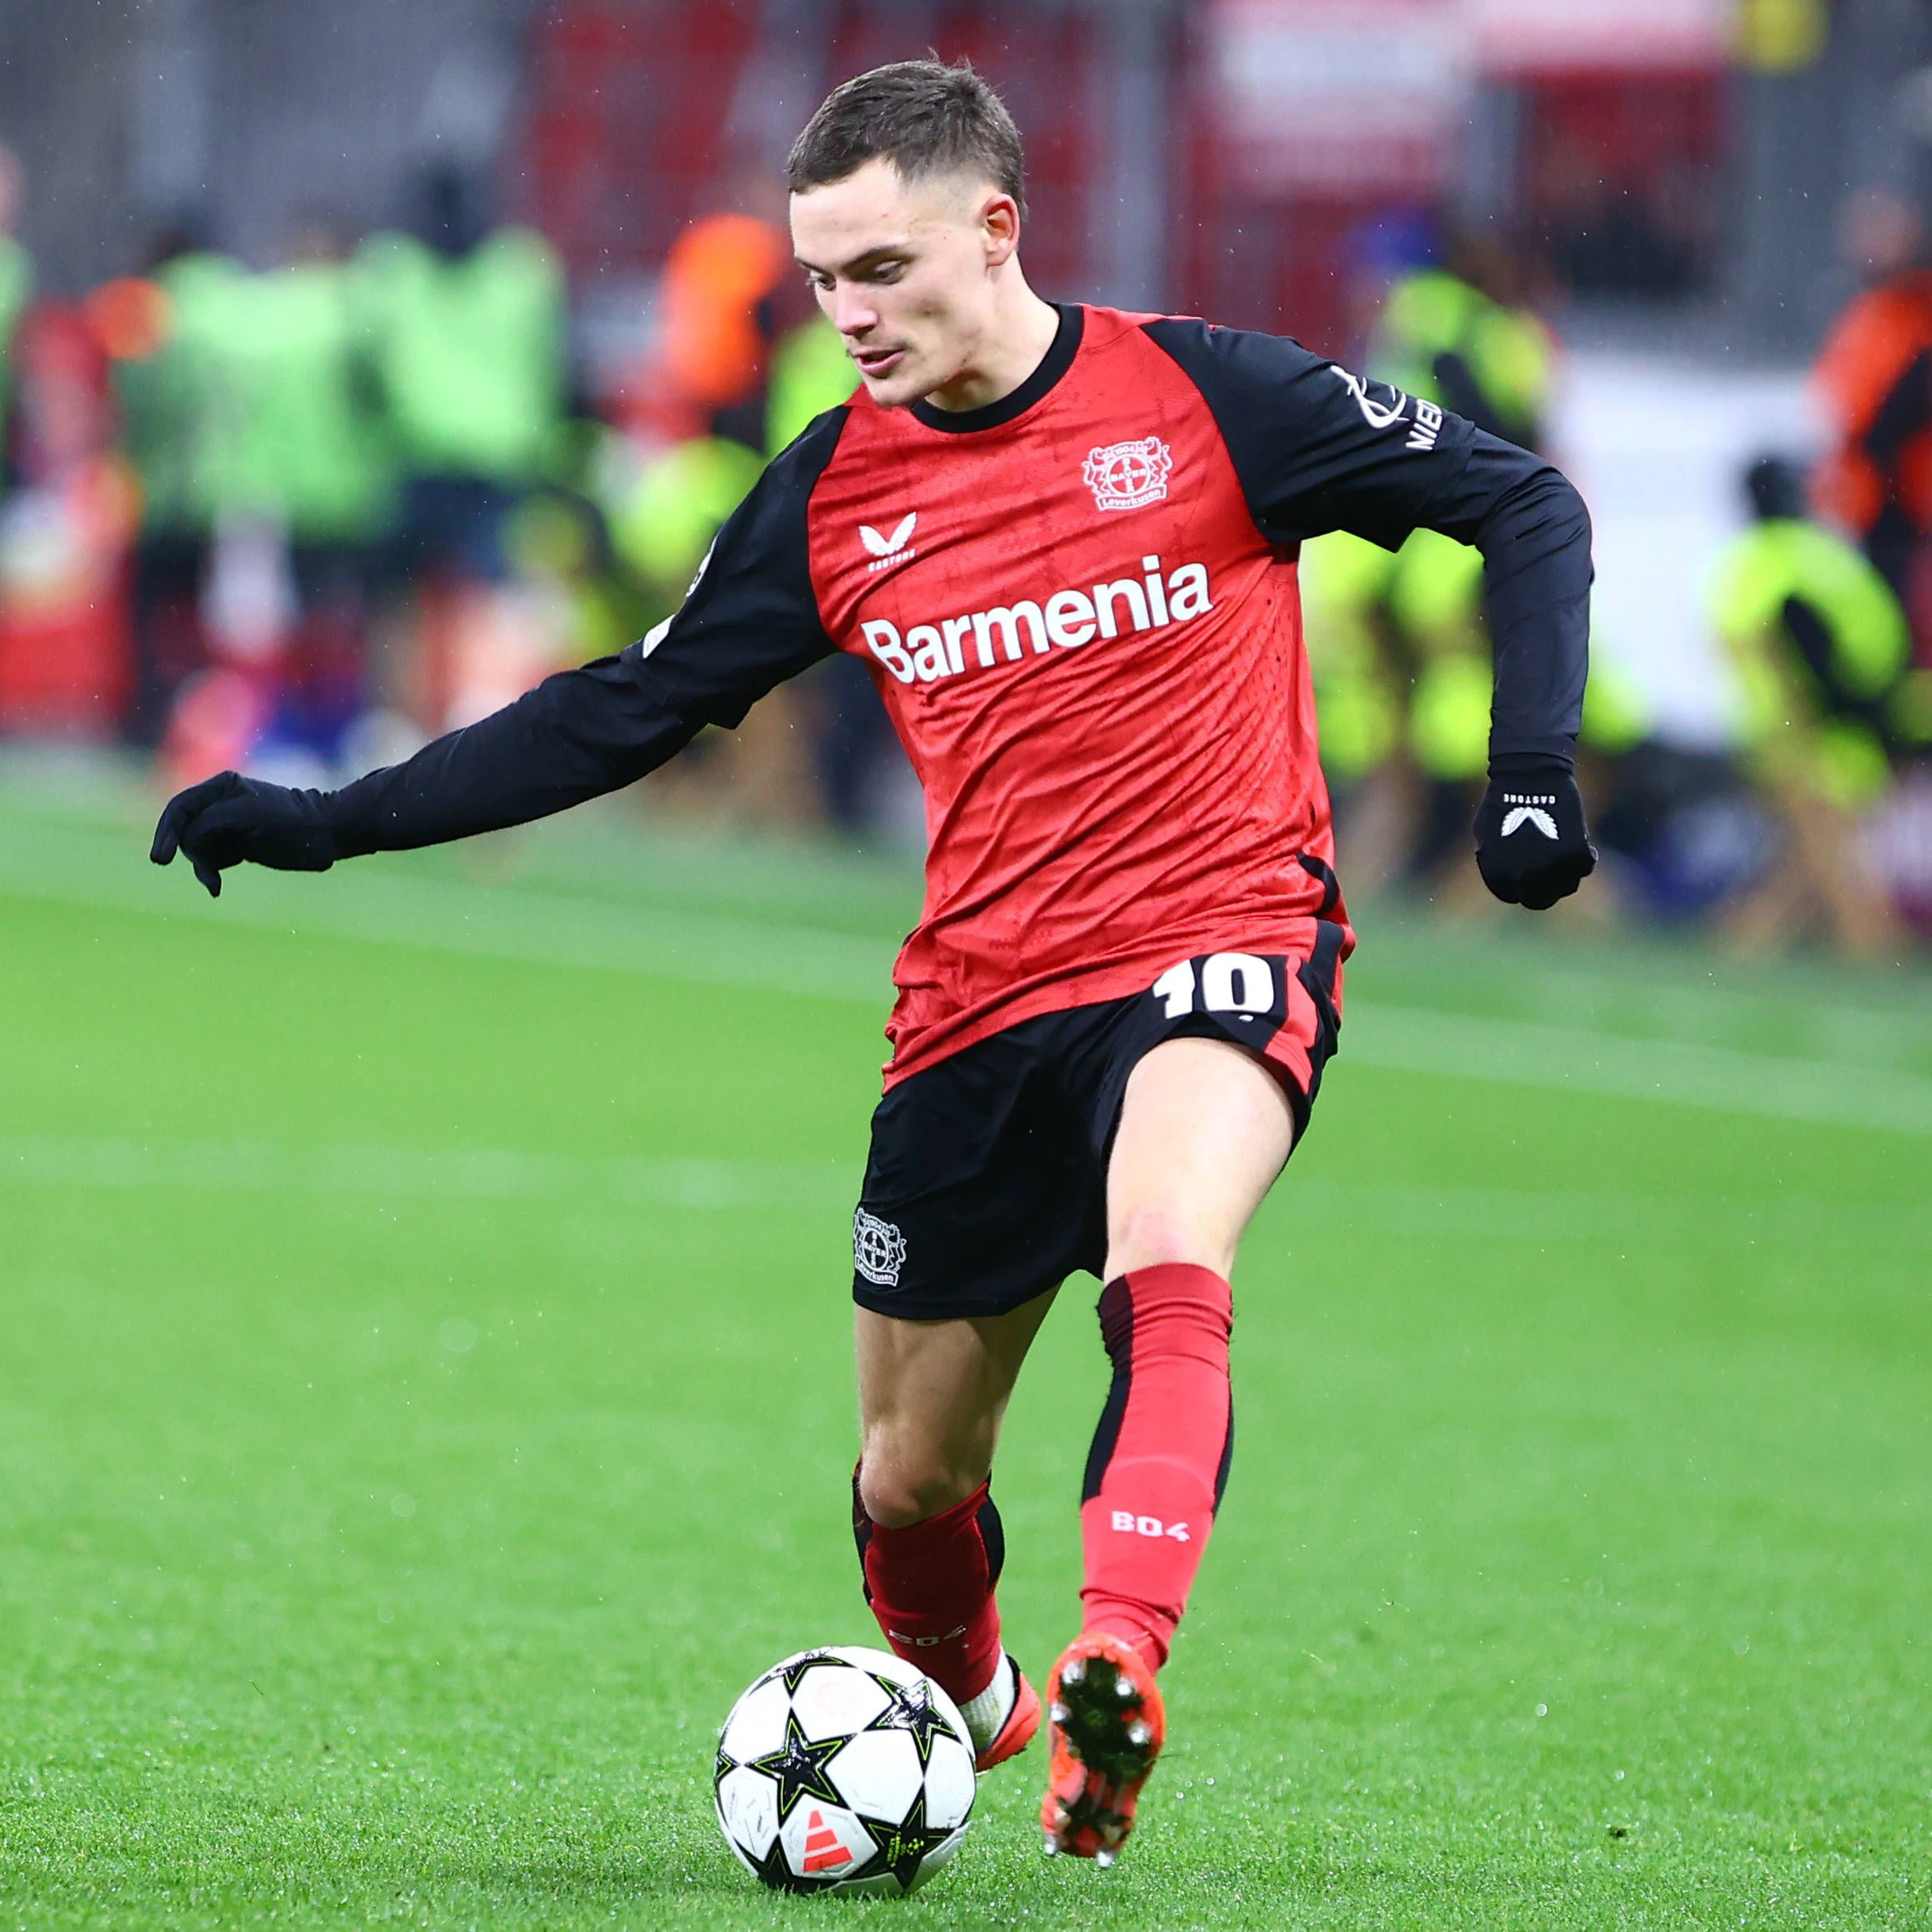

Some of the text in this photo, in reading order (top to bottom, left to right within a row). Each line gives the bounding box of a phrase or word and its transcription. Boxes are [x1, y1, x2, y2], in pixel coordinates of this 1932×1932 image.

[861, 555, 1213, 684] Barmenia
[1503, 794, 1555, 804] CASTORE
[1152, 952, 1275, 1020] 10
